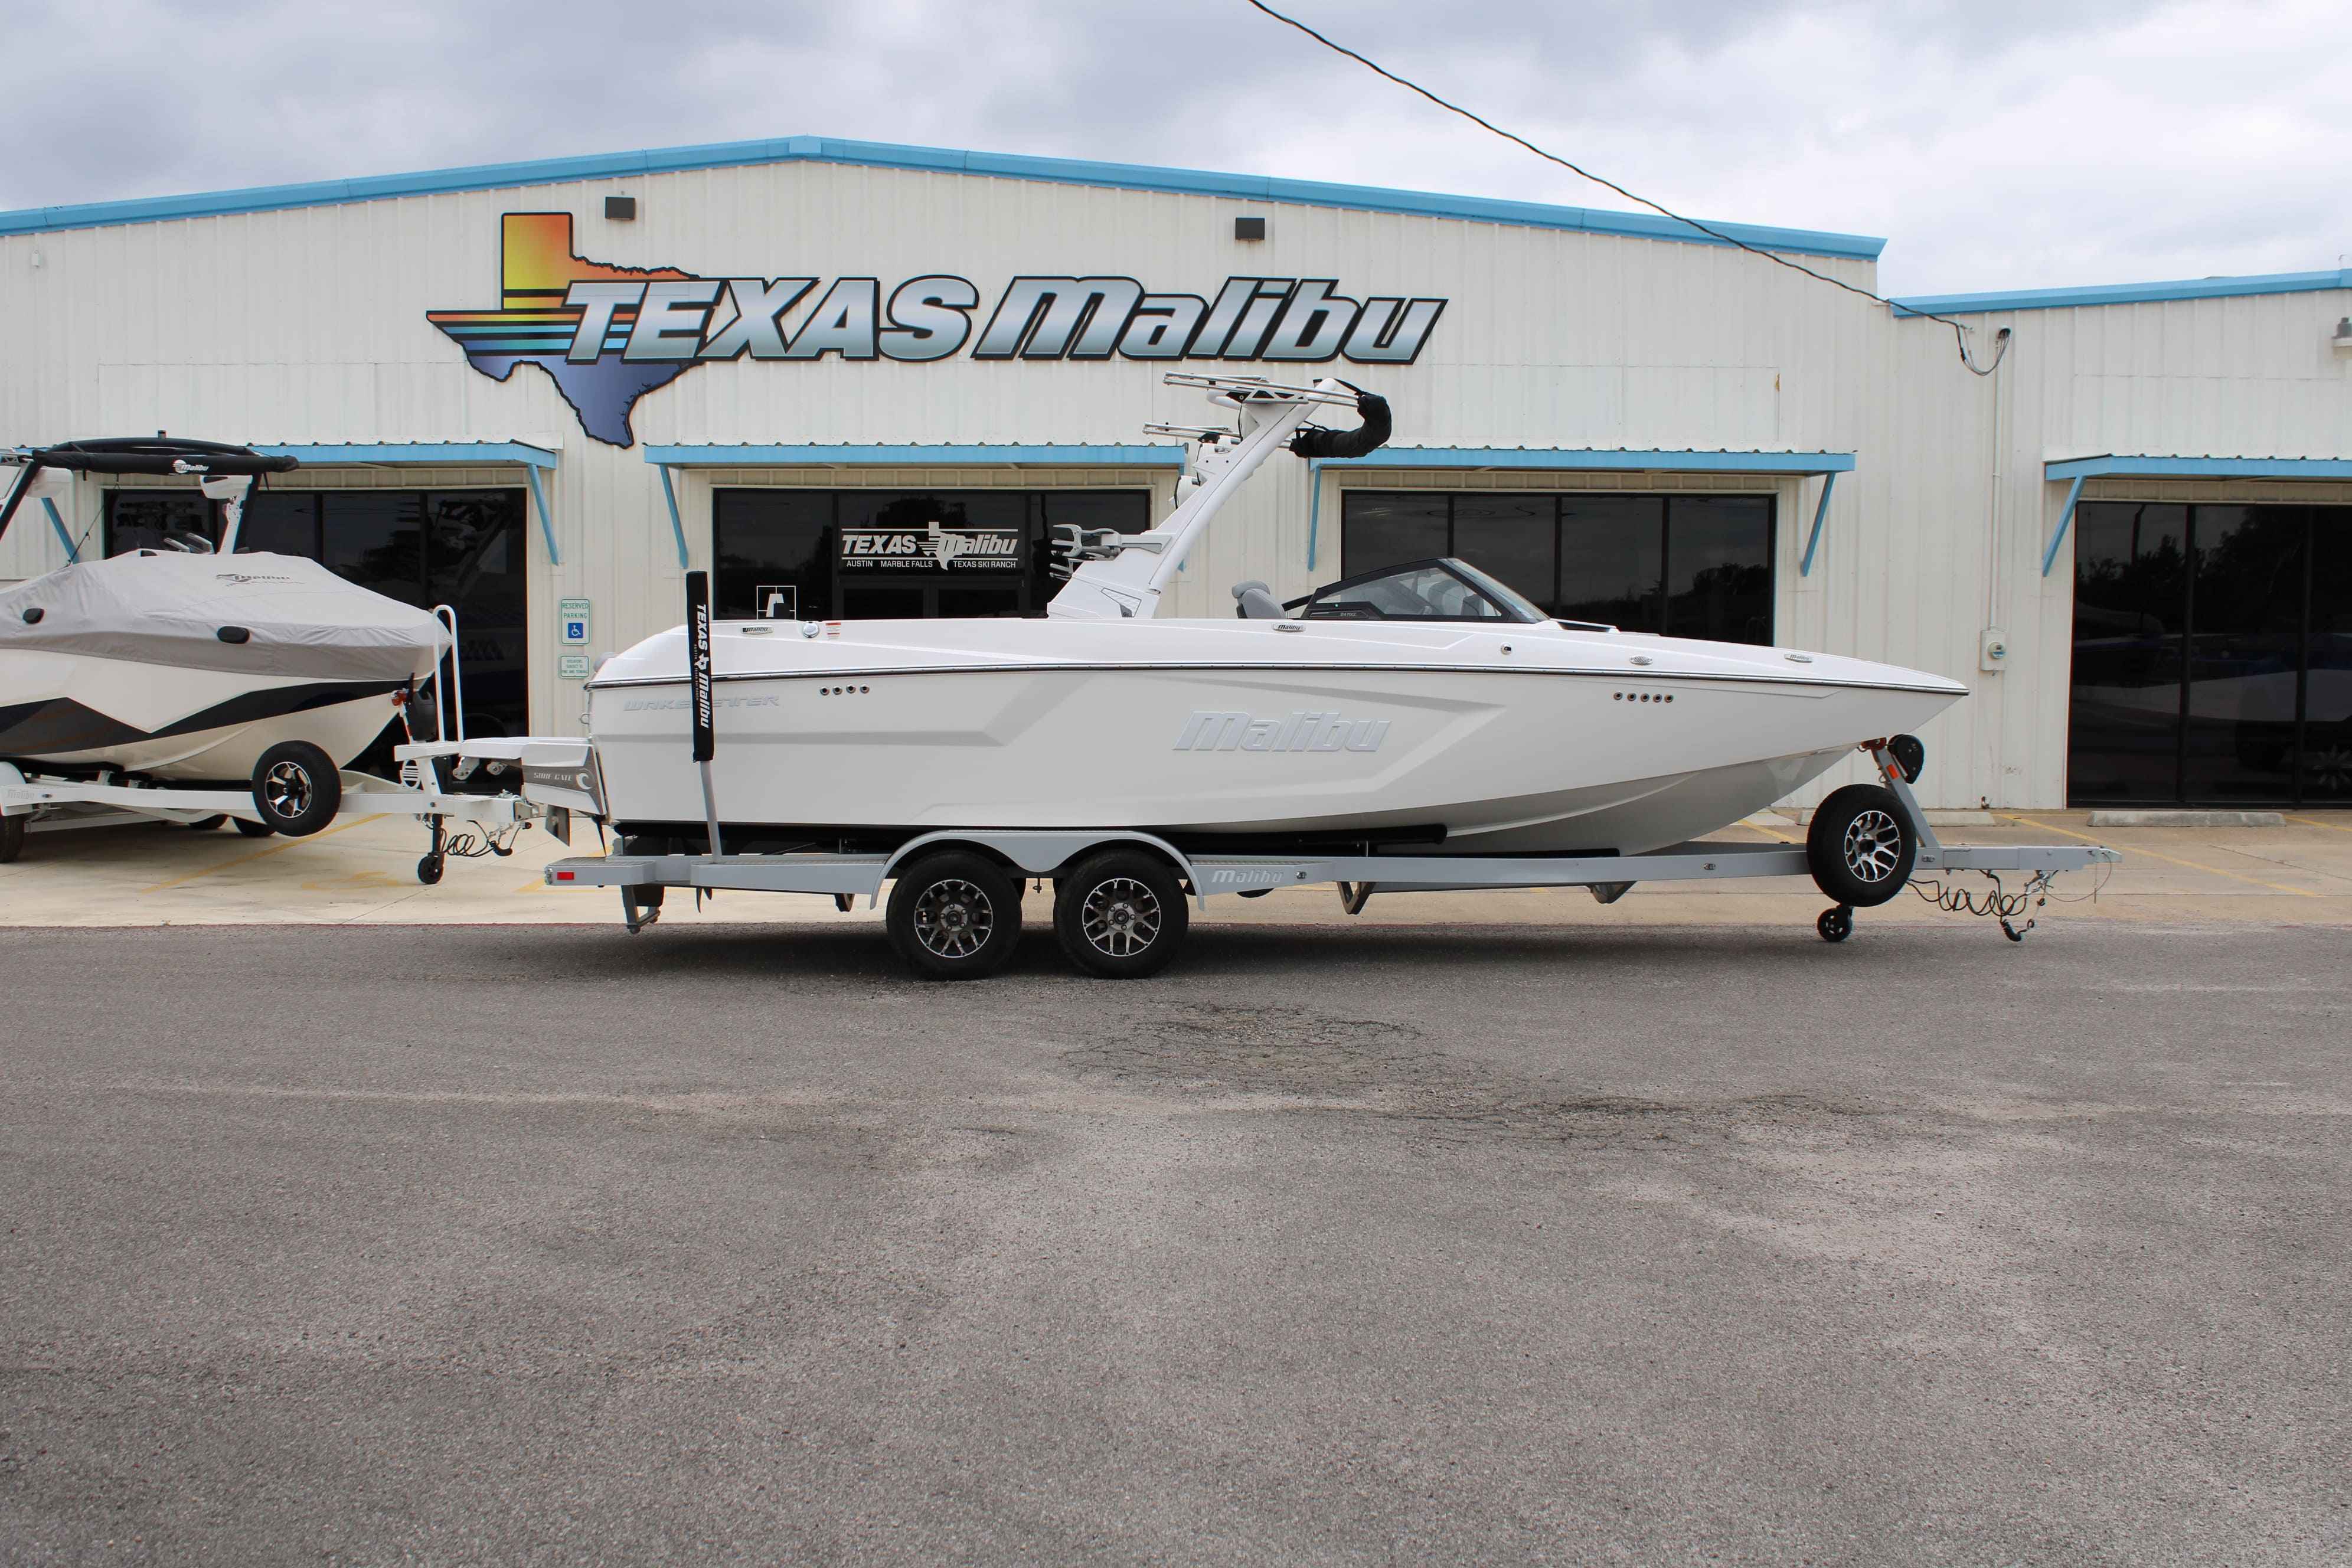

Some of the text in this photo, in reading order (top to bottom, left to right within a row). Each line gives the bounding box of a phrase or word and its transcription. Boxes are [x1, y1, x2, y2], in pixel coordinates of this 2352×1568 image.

[562, 276, 1448, 365] TEXAS Malibu
[842, 534, 1018, 554] TEXAS Malibu
[697, 604, 710, 729] TEXAS Malibu
[623, 695, 780, 711] WAKEETTER
[1171, 711, 1391, 752] Malibu
[1211, 869, 1284, 883] Malibu
